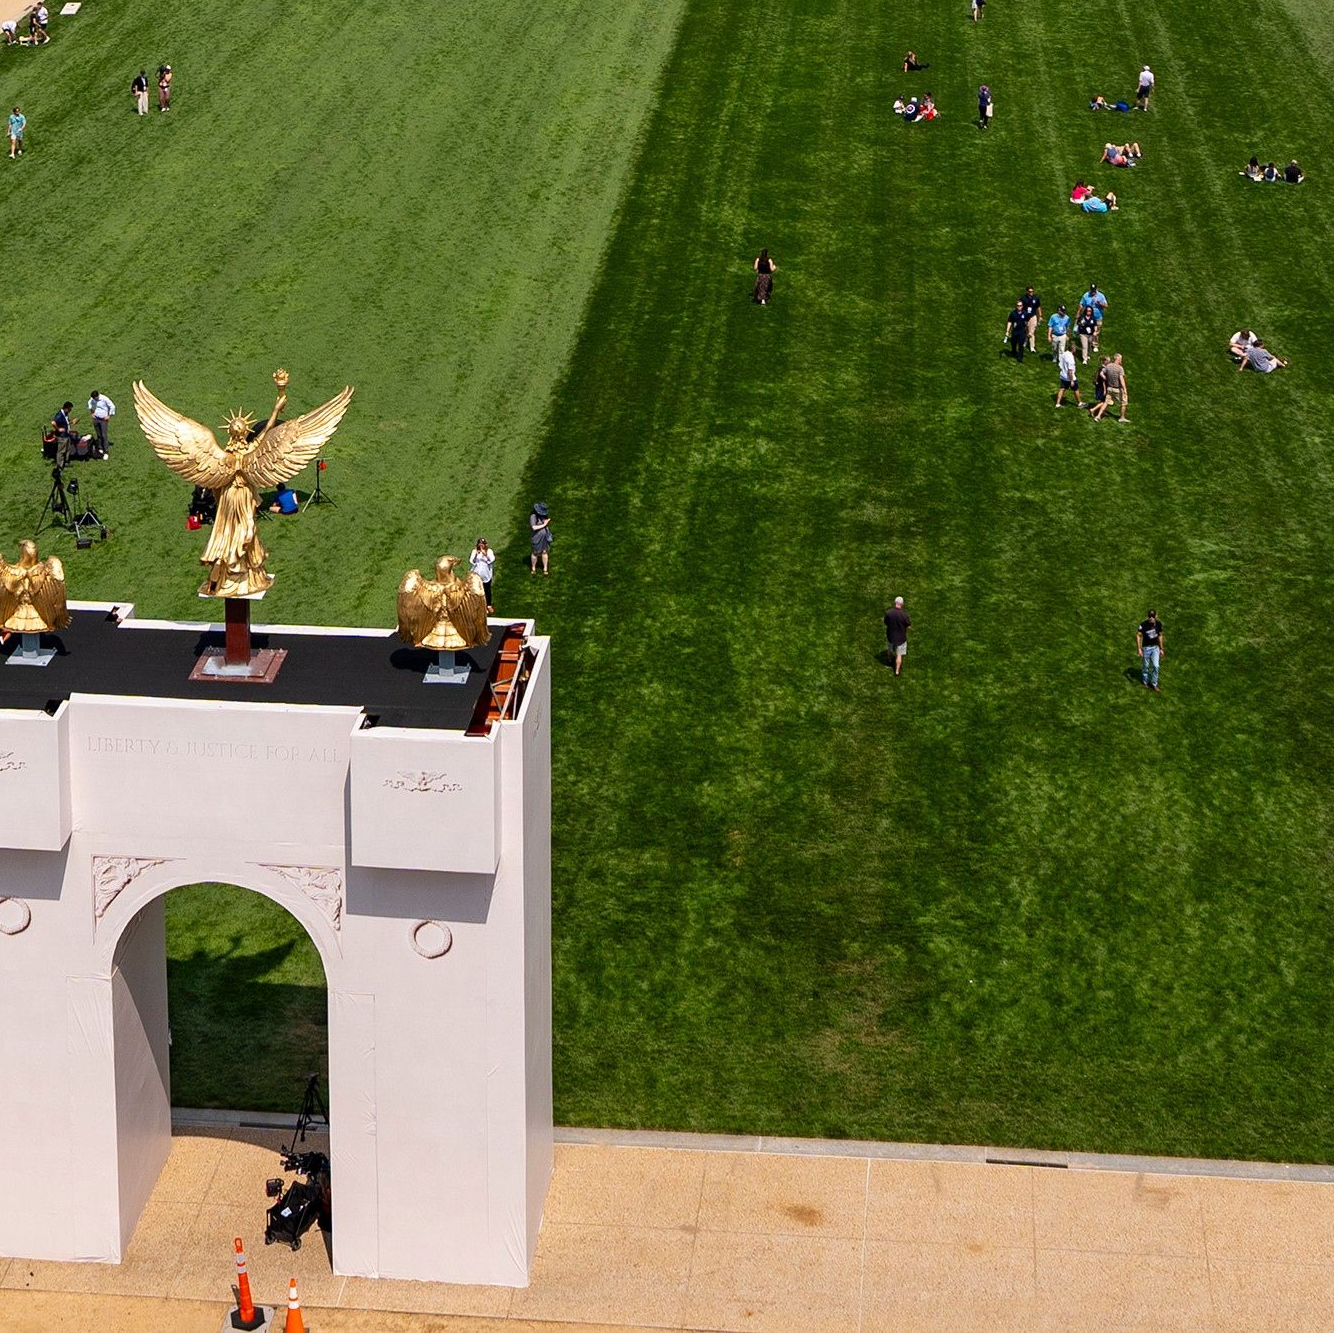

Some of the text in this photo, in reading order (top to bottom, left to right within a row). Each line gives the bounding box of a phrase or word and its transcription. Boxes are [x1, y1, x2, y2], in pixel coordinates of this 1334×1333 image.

[87, 736, 342, 763] LIBERTY & JUSTICE FOR ALL
